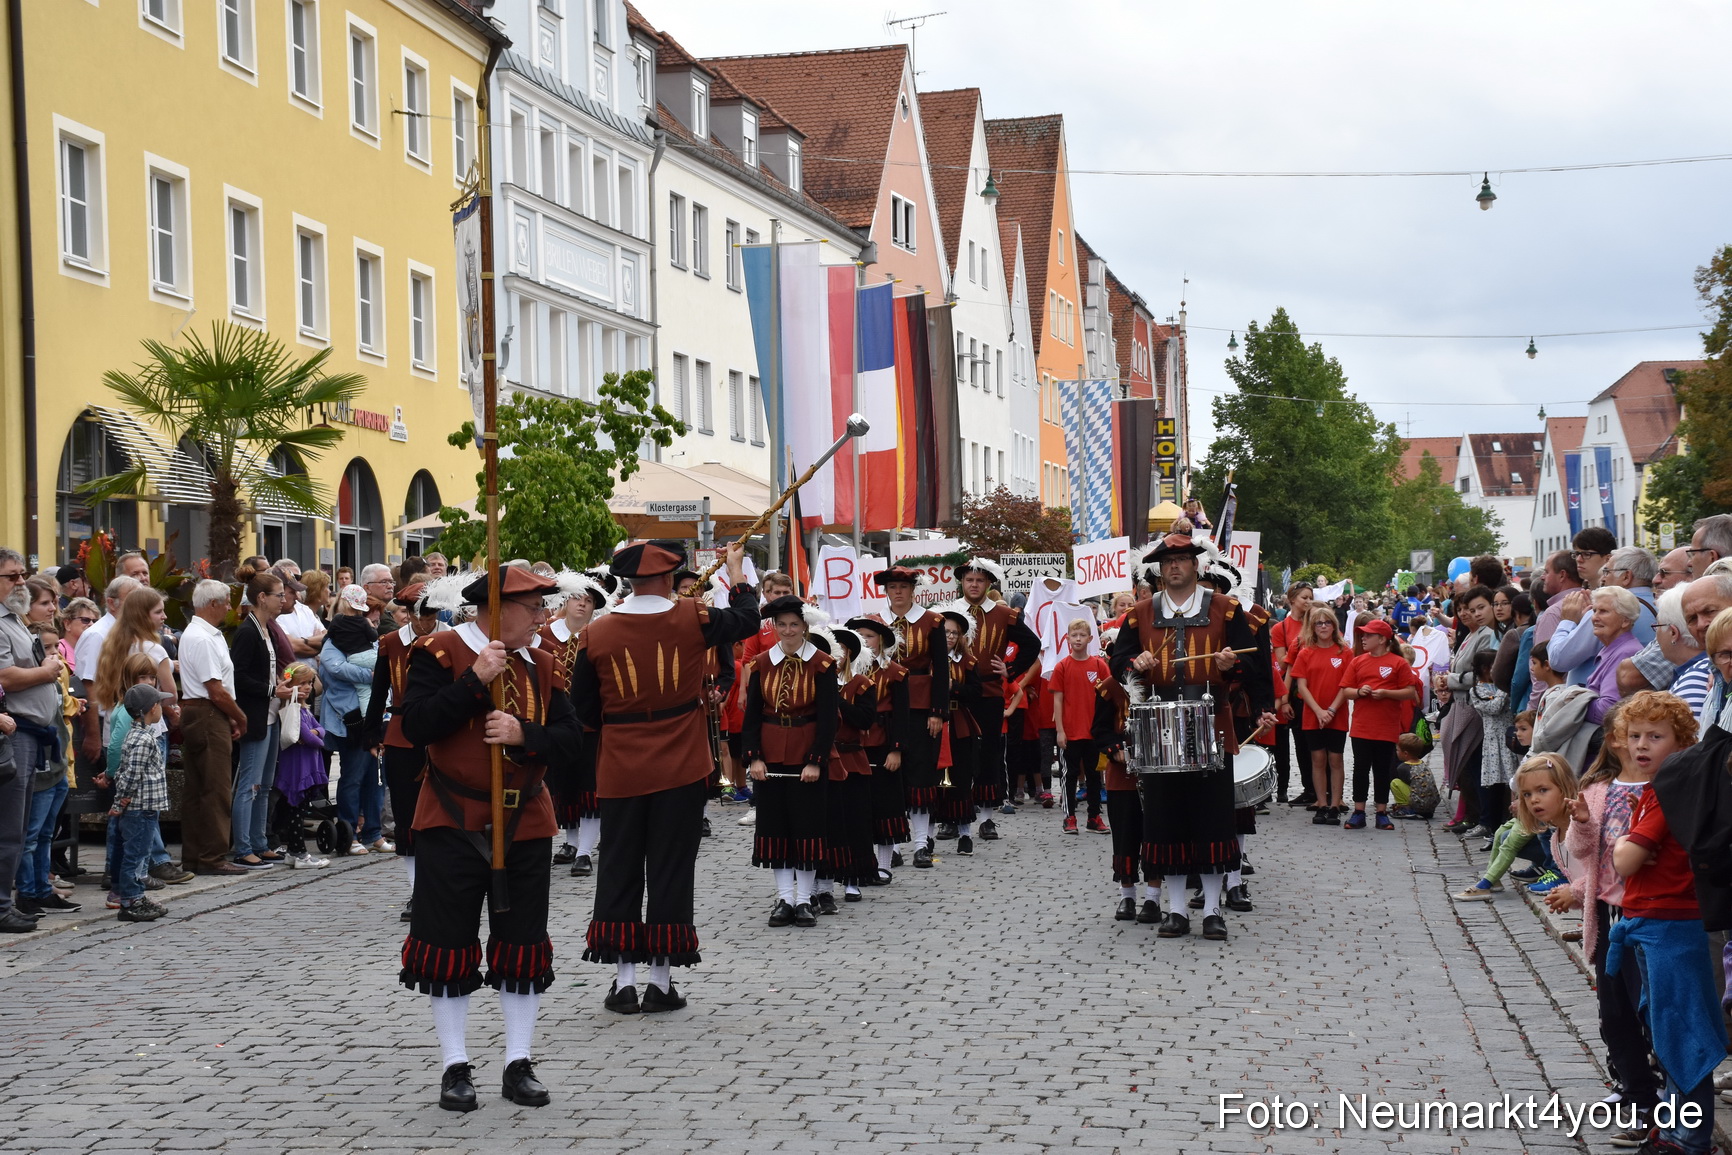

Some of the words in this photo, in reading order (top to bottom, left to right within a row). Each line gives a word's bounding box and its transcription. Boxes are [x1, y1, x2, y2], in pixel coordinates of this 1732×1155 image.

[546, 241, 578, 276] BRILLEN
[578, 253, 608, 288] WEBER
[366, 411, 390, 432] RATHAUS
[1157, 420, 1175, 498] HOTE
[649, 503, 697, 514] Klostergasse
[1001, 556, 1065, 566] TURNABTEILUNG
[1028, 569, 1039, 577] SV
[1077, 550, 1127, 585] STARKE
[824, 557, 854, 600] B
